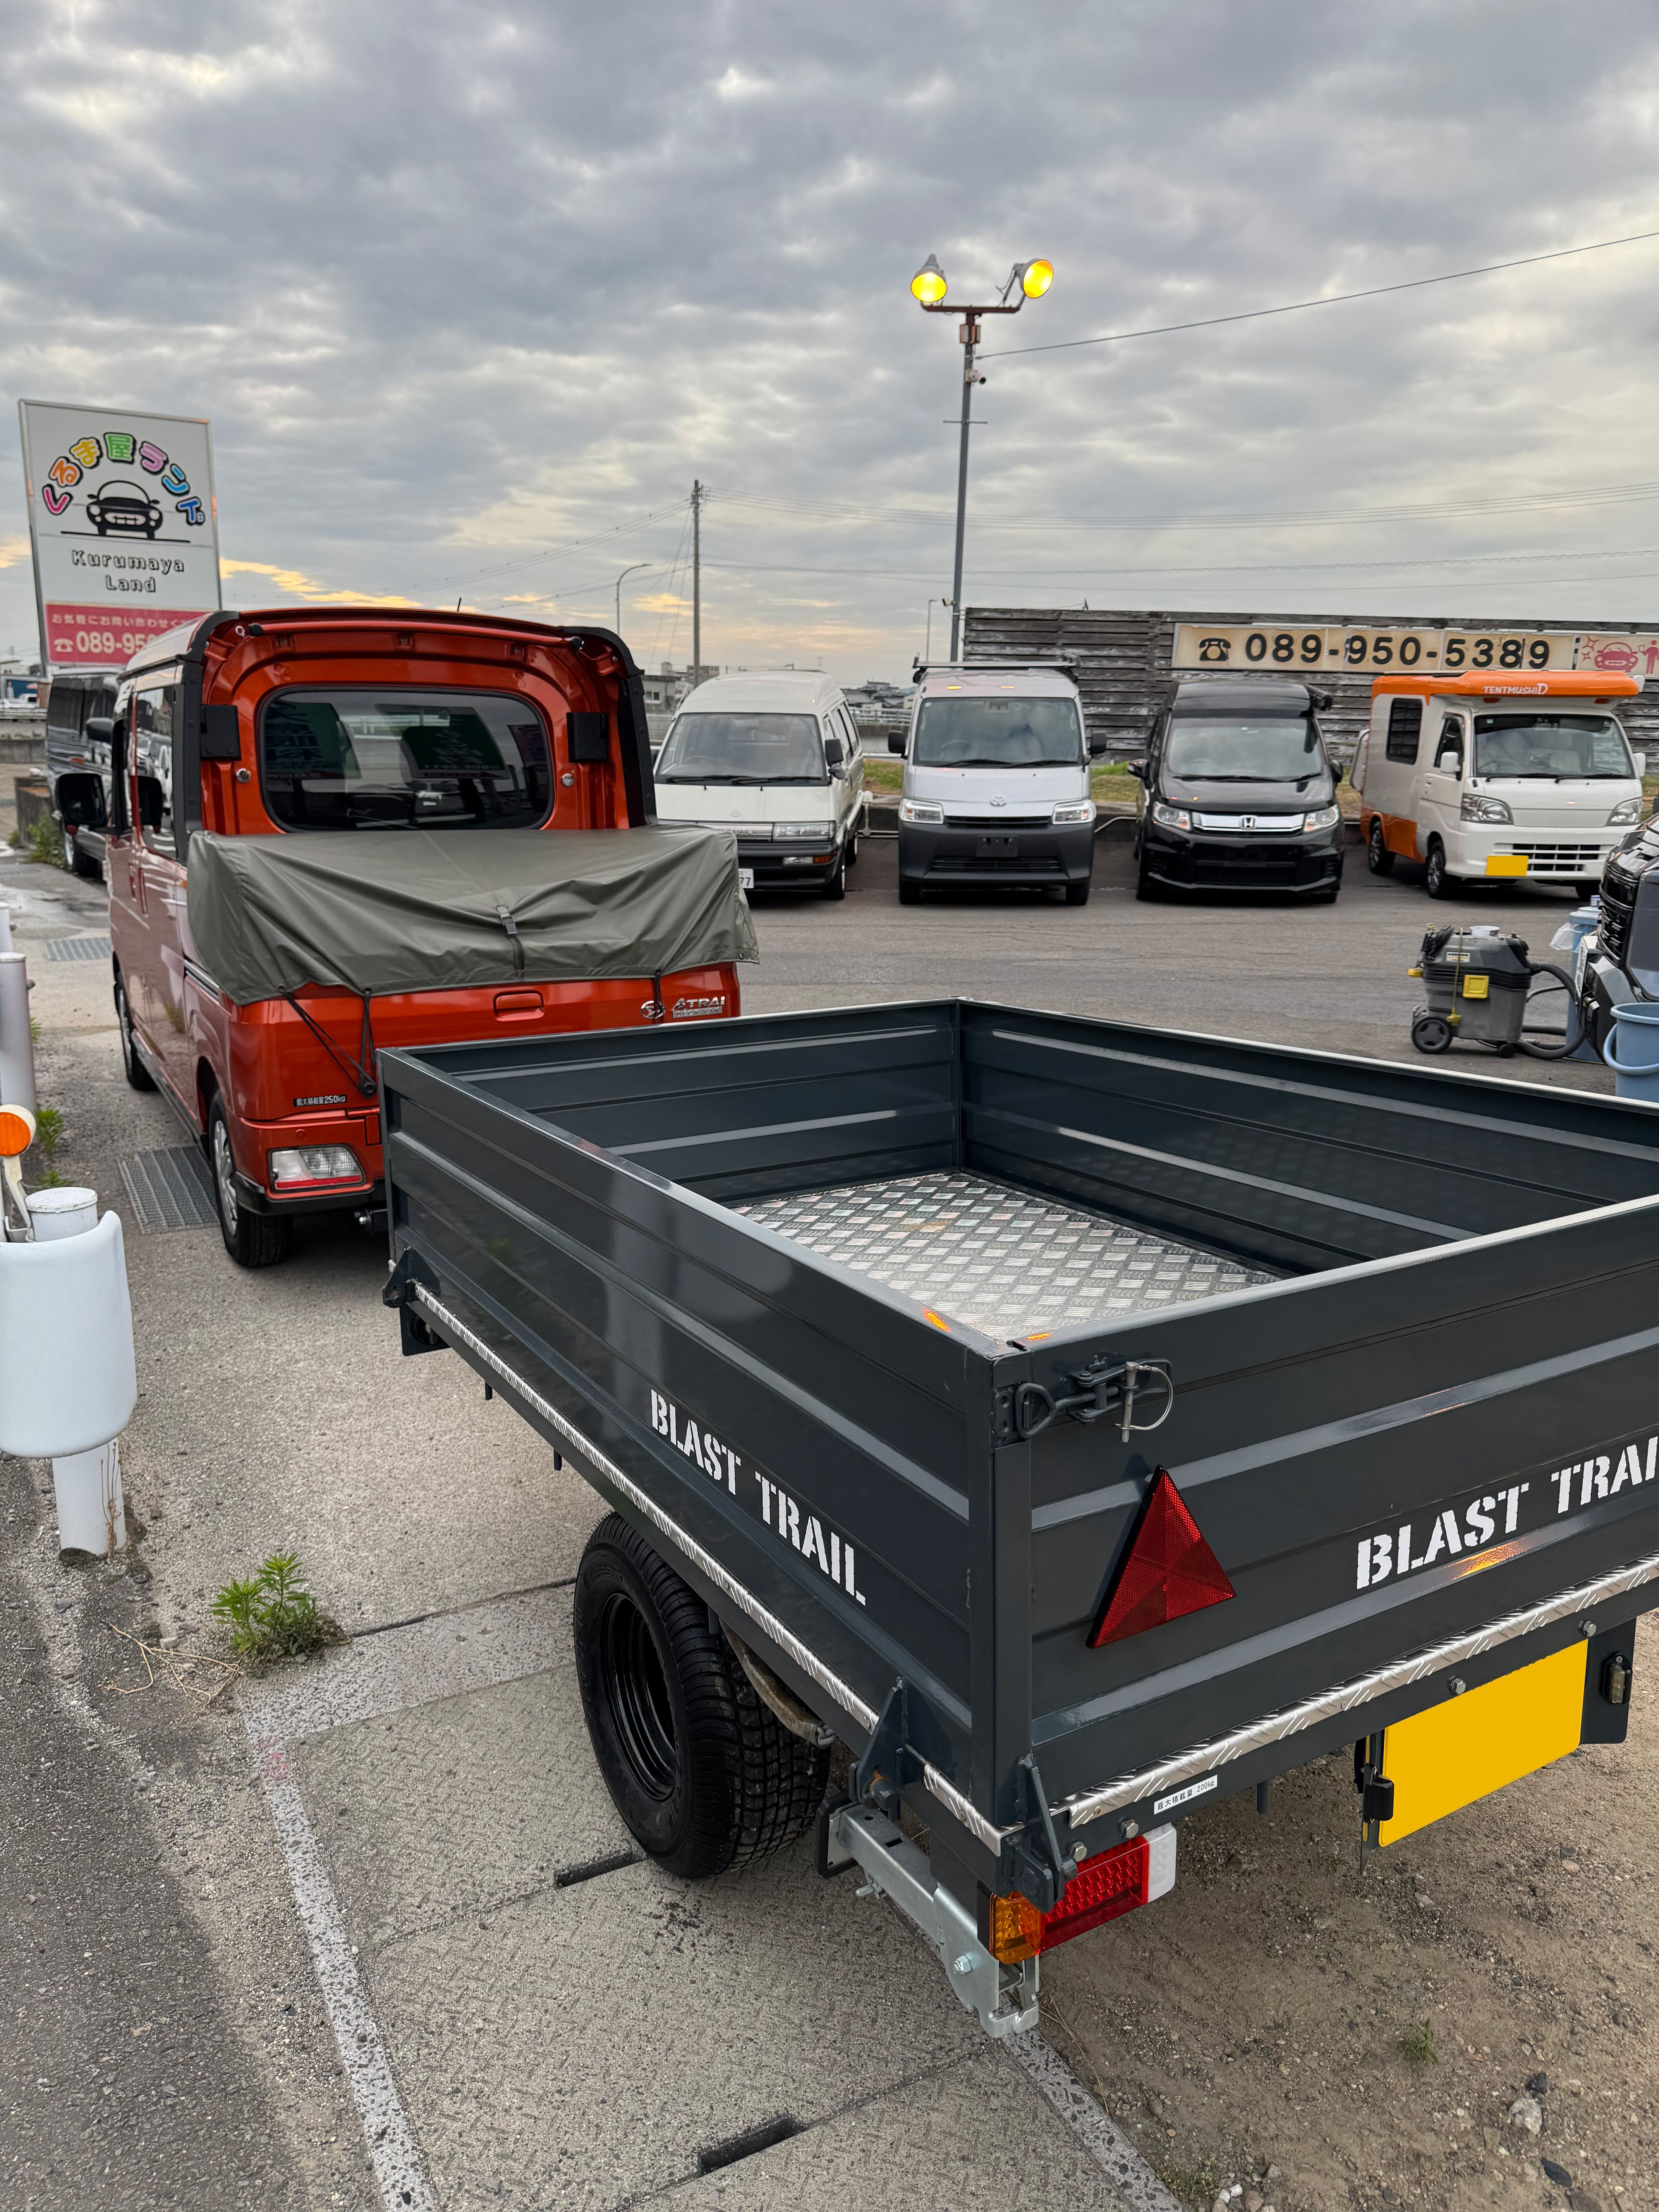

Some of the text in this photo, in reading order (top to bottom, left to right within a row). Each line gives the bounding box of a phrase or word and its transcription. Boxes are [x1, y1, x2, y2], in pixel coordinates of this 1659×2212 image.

[42, 432, 205, 525] くるま屋ランド
[71, 549, 184, 575] Kurumaya
[105, 574, 156, 593] Land
[1245, 633, 1549, 669] 089-950-5389
[671, 996, 725, 1012] ATRAI
[651, 1389, 866, 1606] BLAST TRAIL
[1356, 1436, 1659, 1589] BLAST TRAI
[1158, 1781, 1214, 1810] 最大積載量 200kg
